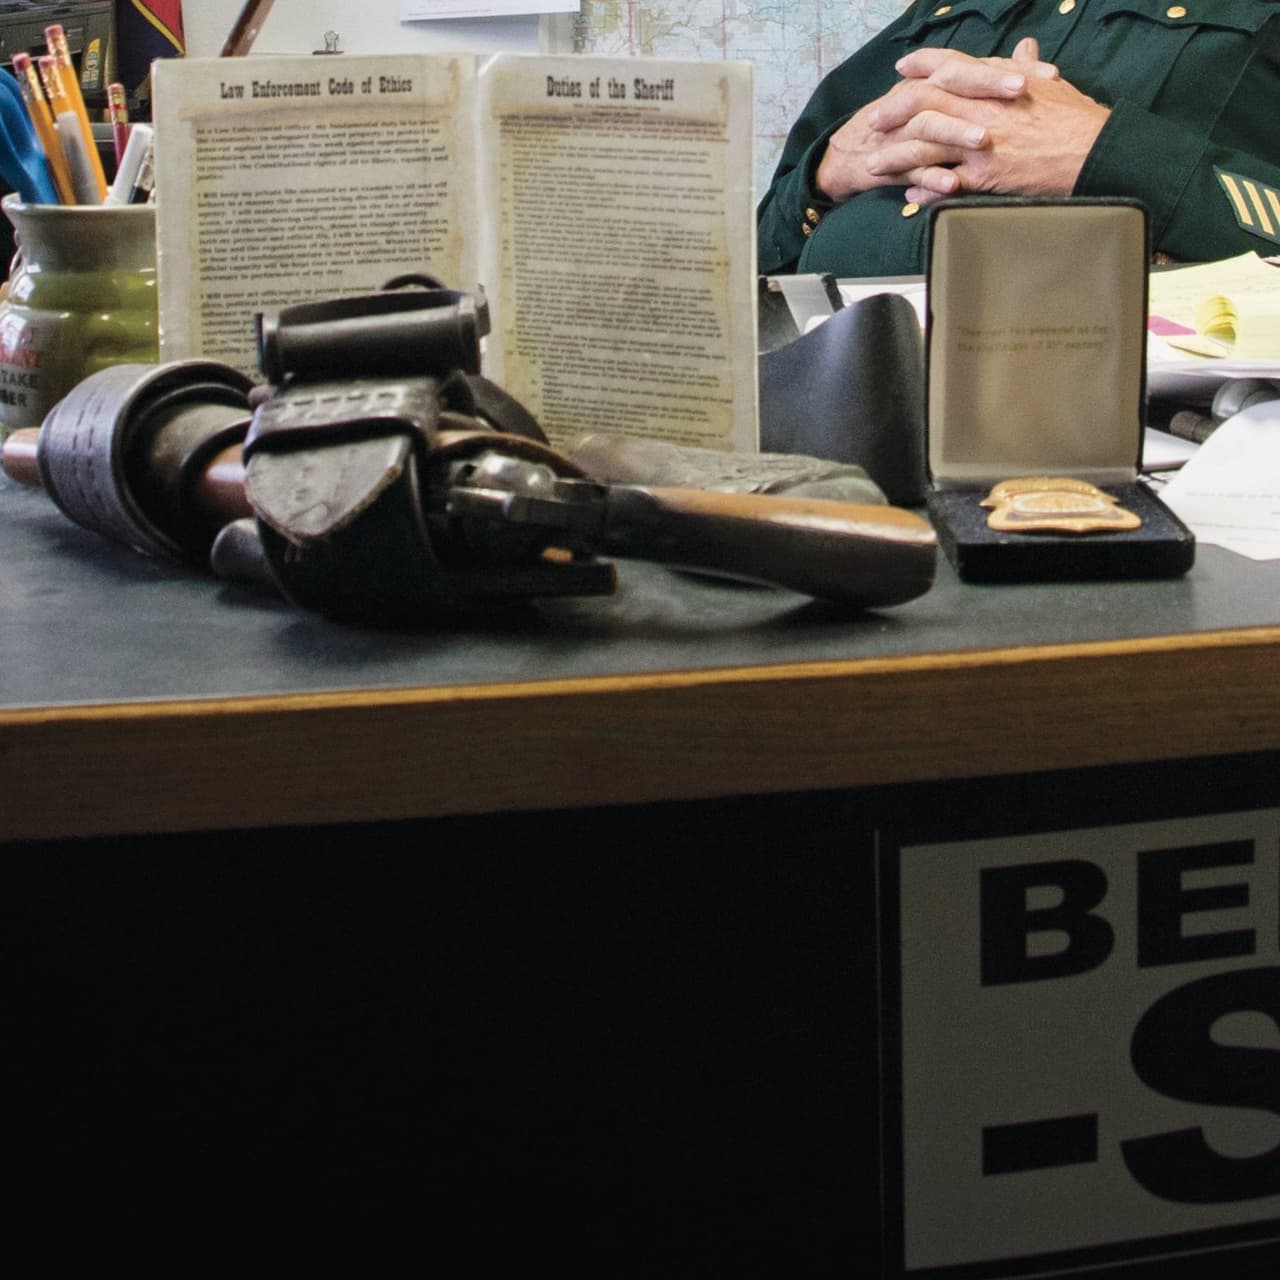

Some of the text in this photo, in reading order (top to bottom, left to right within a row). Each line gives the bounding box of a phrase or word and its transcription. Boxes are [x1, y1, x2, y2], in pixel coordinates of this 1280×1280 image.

[220, 76, 413, 100] Law Enforcement Code of Ethics
[546, 76, 675, 101] Duties of the Sheriff
